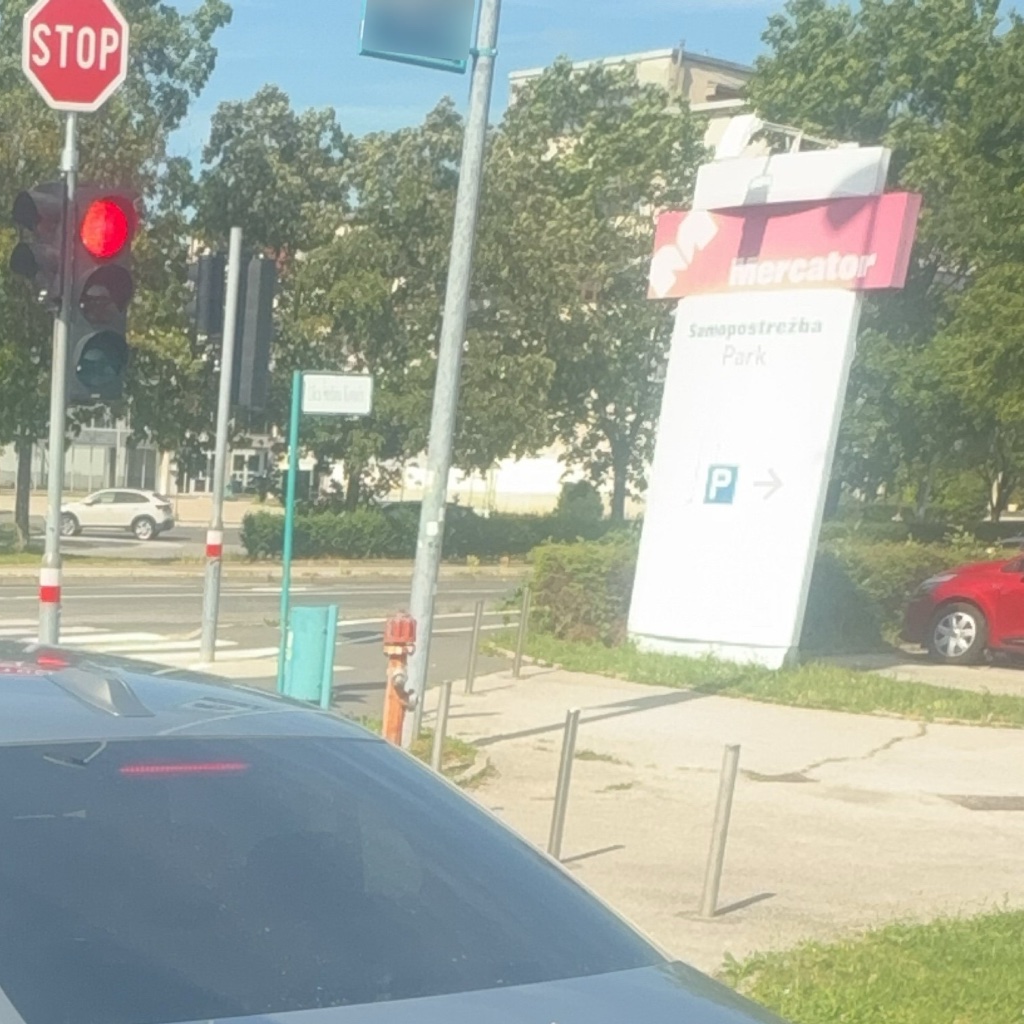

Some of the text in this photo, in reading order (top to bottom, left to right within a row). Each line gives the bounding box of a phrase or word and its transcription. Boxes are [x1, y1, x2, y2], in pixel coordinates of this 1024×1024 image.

[32, 23, 119, 71] STOP
[688, 316, 822, 340] Samopostrežba
[722, 344, 766, 366] Park
[709, 467, 733, 500] P
